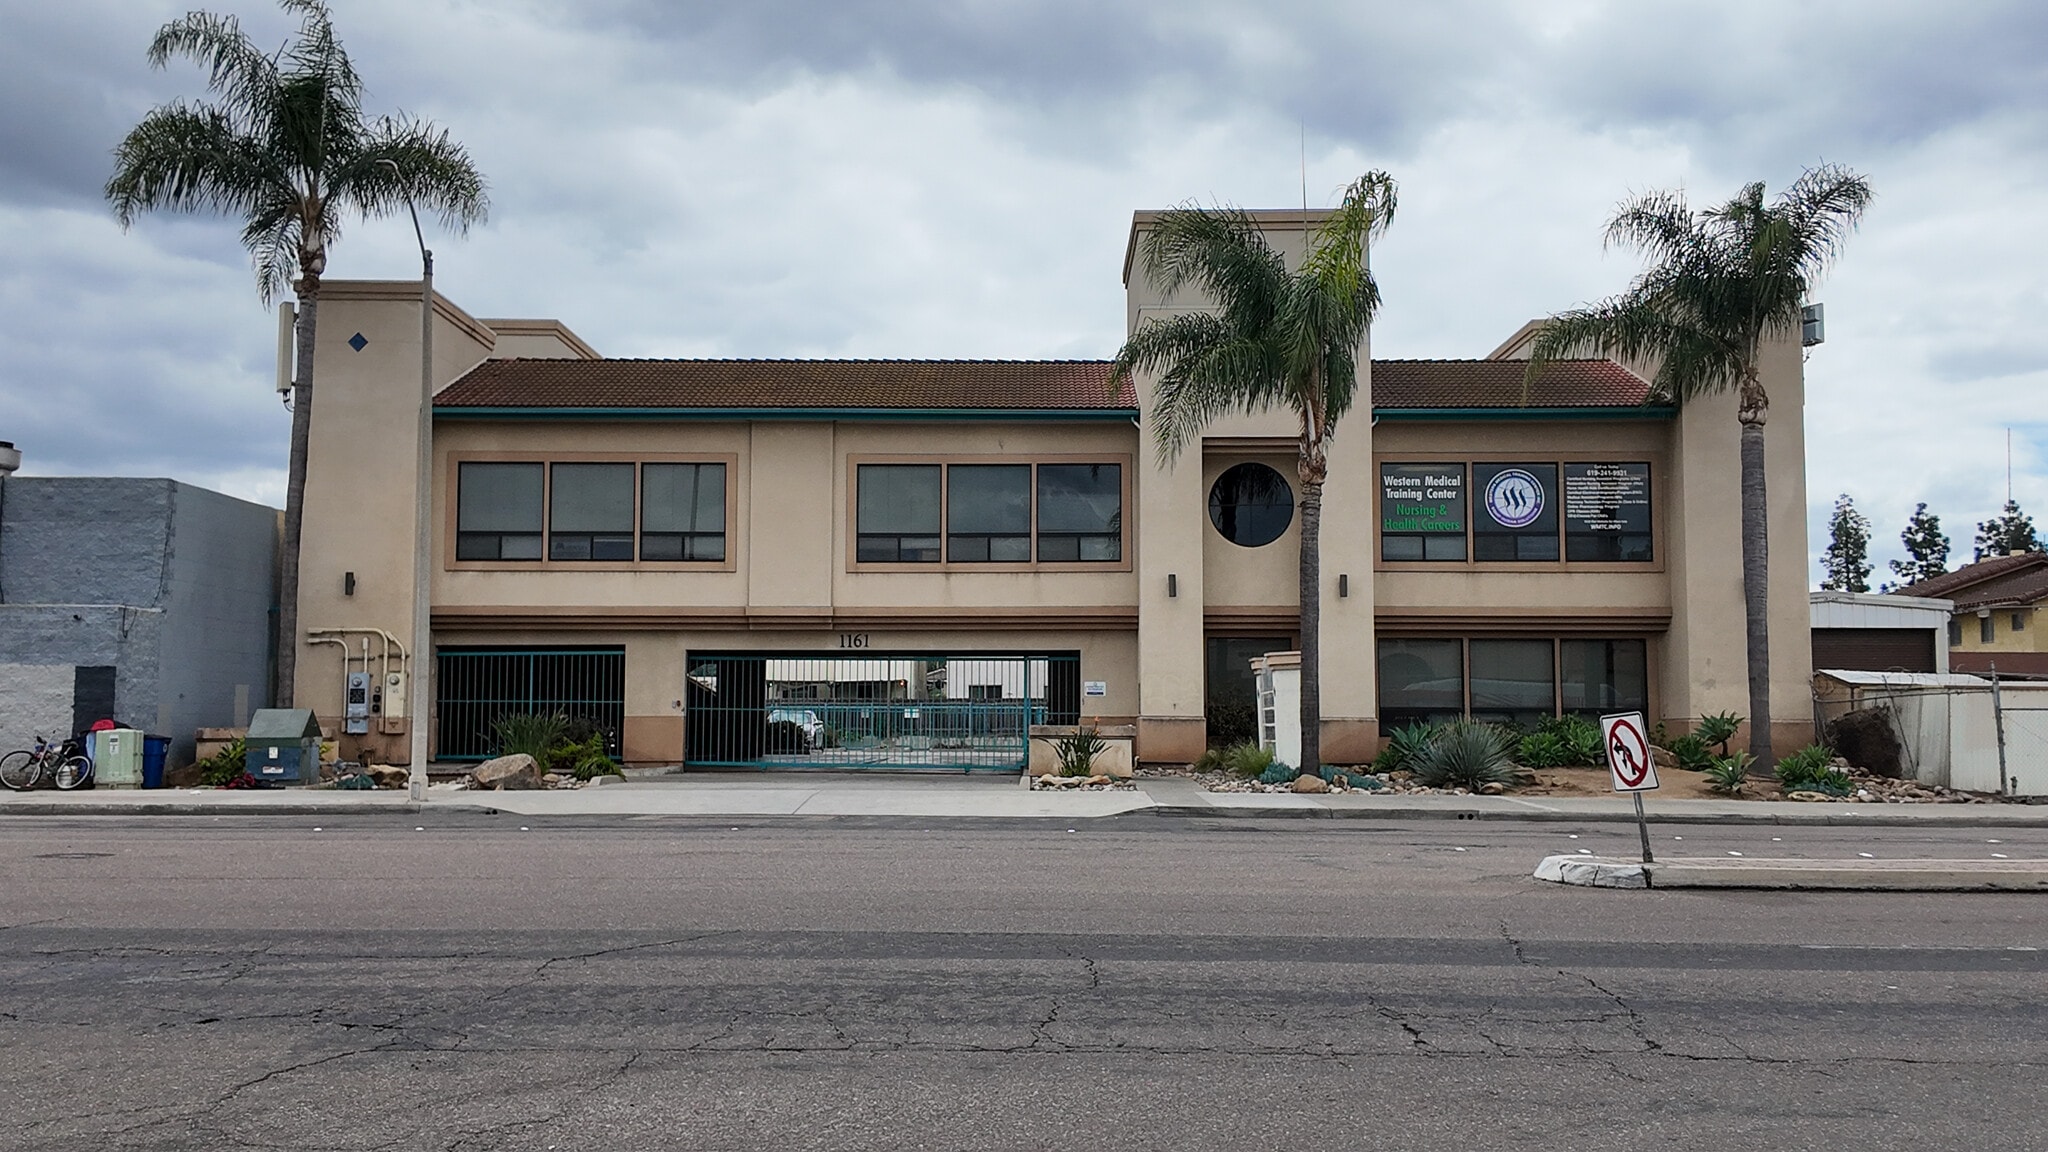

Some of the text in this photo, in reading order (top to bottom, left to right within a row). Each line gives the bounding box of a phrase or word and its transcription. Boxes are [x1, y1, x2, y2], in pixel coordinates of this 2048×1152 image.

[1383, 475, 1461, 486] Western Medical
[1385, 488, 1457, 501] Training Center
[1396, 504, 1447, 518] Nursing &
[1384, 518, 1460, 530] Health Careers
[840, 633, 869, 648] 1161
